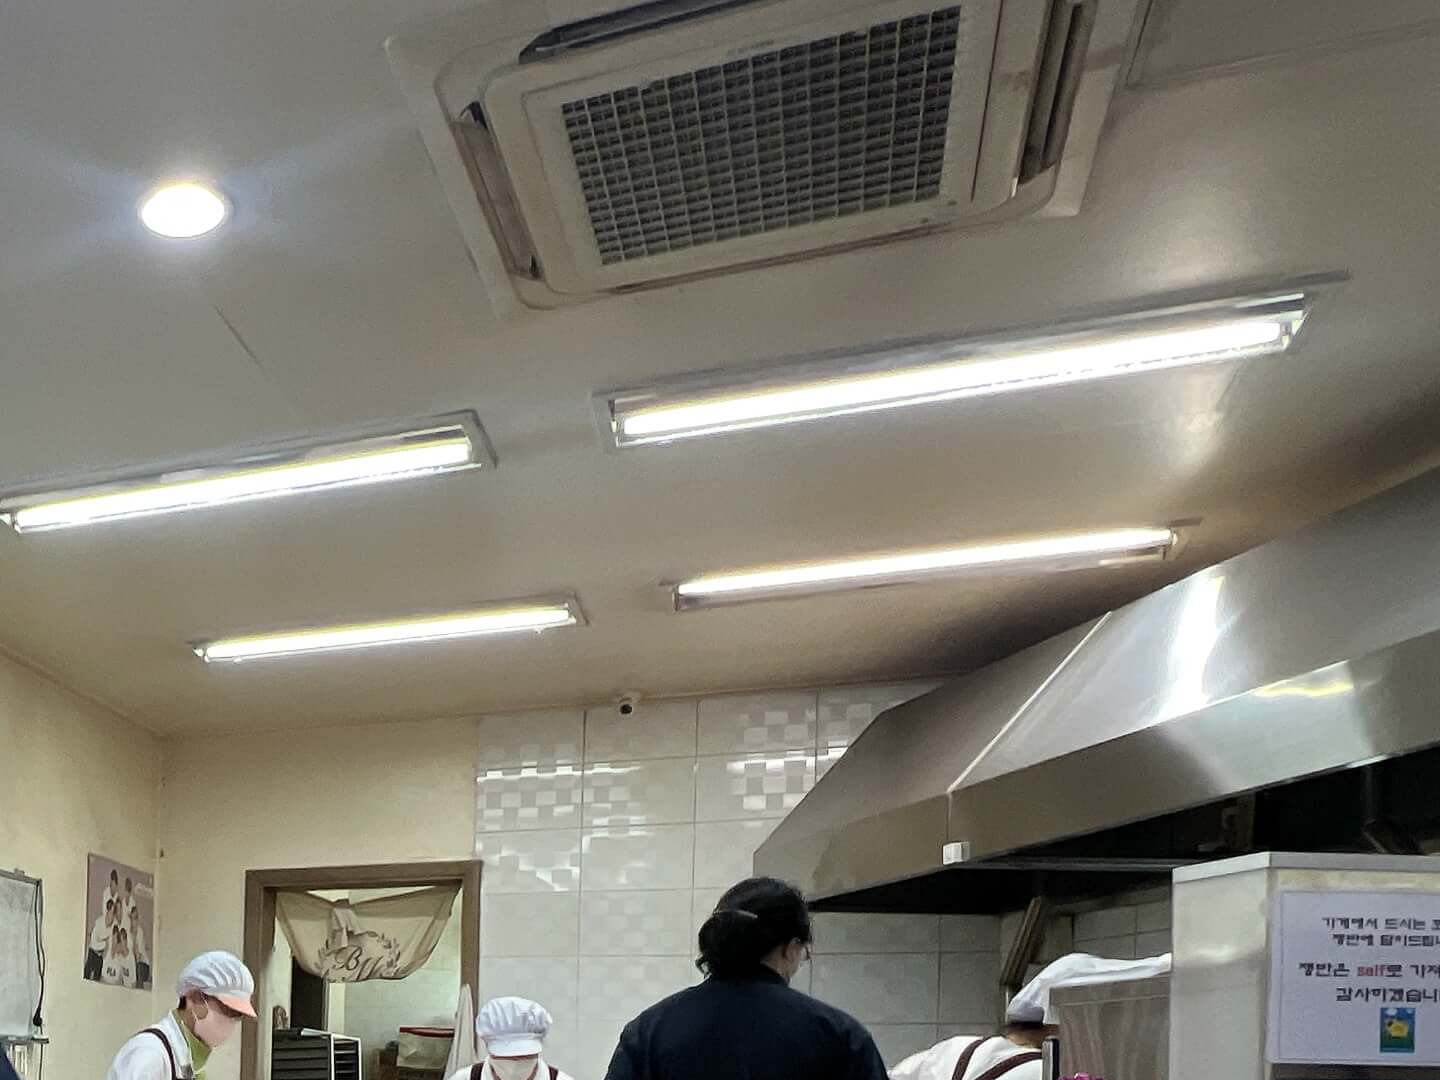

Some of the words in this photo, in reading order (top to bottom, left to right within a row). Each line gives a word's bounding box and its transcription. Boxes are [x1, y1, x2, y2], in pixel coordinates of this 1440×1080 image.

[1384, 918, 1427, 931] 드시는
[1299, 962, 1351, 977] 쟁반은
[1336, 987, 1440, 1003] 감사하겠습니
